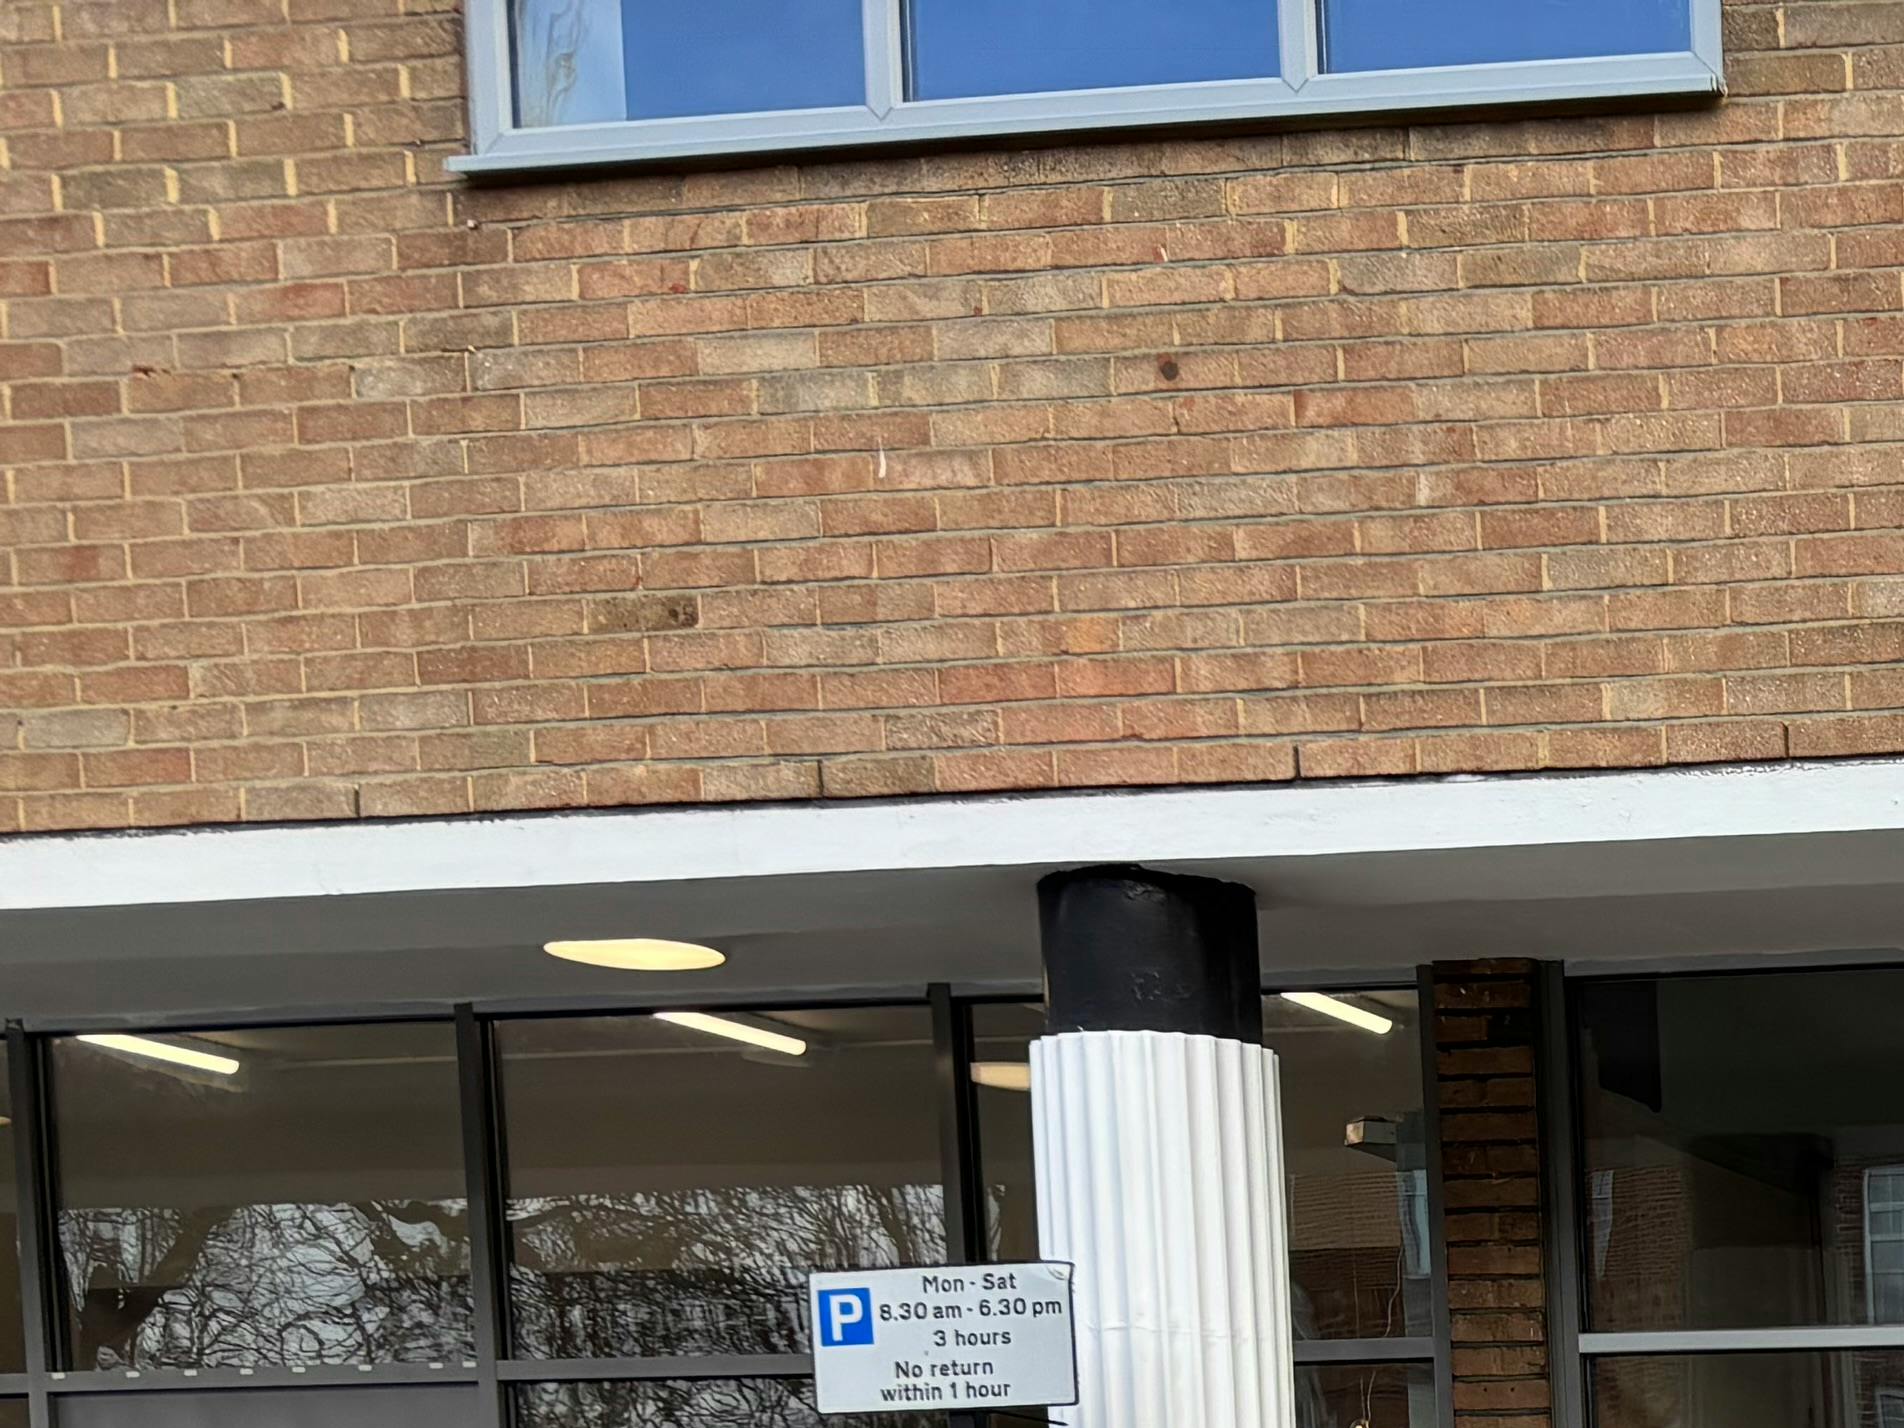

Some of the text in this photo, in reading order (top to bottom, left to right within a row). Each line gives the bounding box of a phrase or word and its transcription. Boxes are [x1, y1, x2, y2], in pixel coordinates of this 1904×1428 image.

[922, 1275, 965, 1294] Mon
[981, 1272, 1017, 1291] Sat
[828, 1293, 864, 1342] P
[879, 1302, 928, 1322] 8.30
[932, 1304, 963, 1319] am
[978, 1297, 1027, 1317] 6.30
[1032, 1299, 1062, 1318] pm
[933, 1328, 1012, 1347] 3 hours
[894, 1360, 994, 1379] No return
[880, 1380, 1011, 1402] within 1 hour
